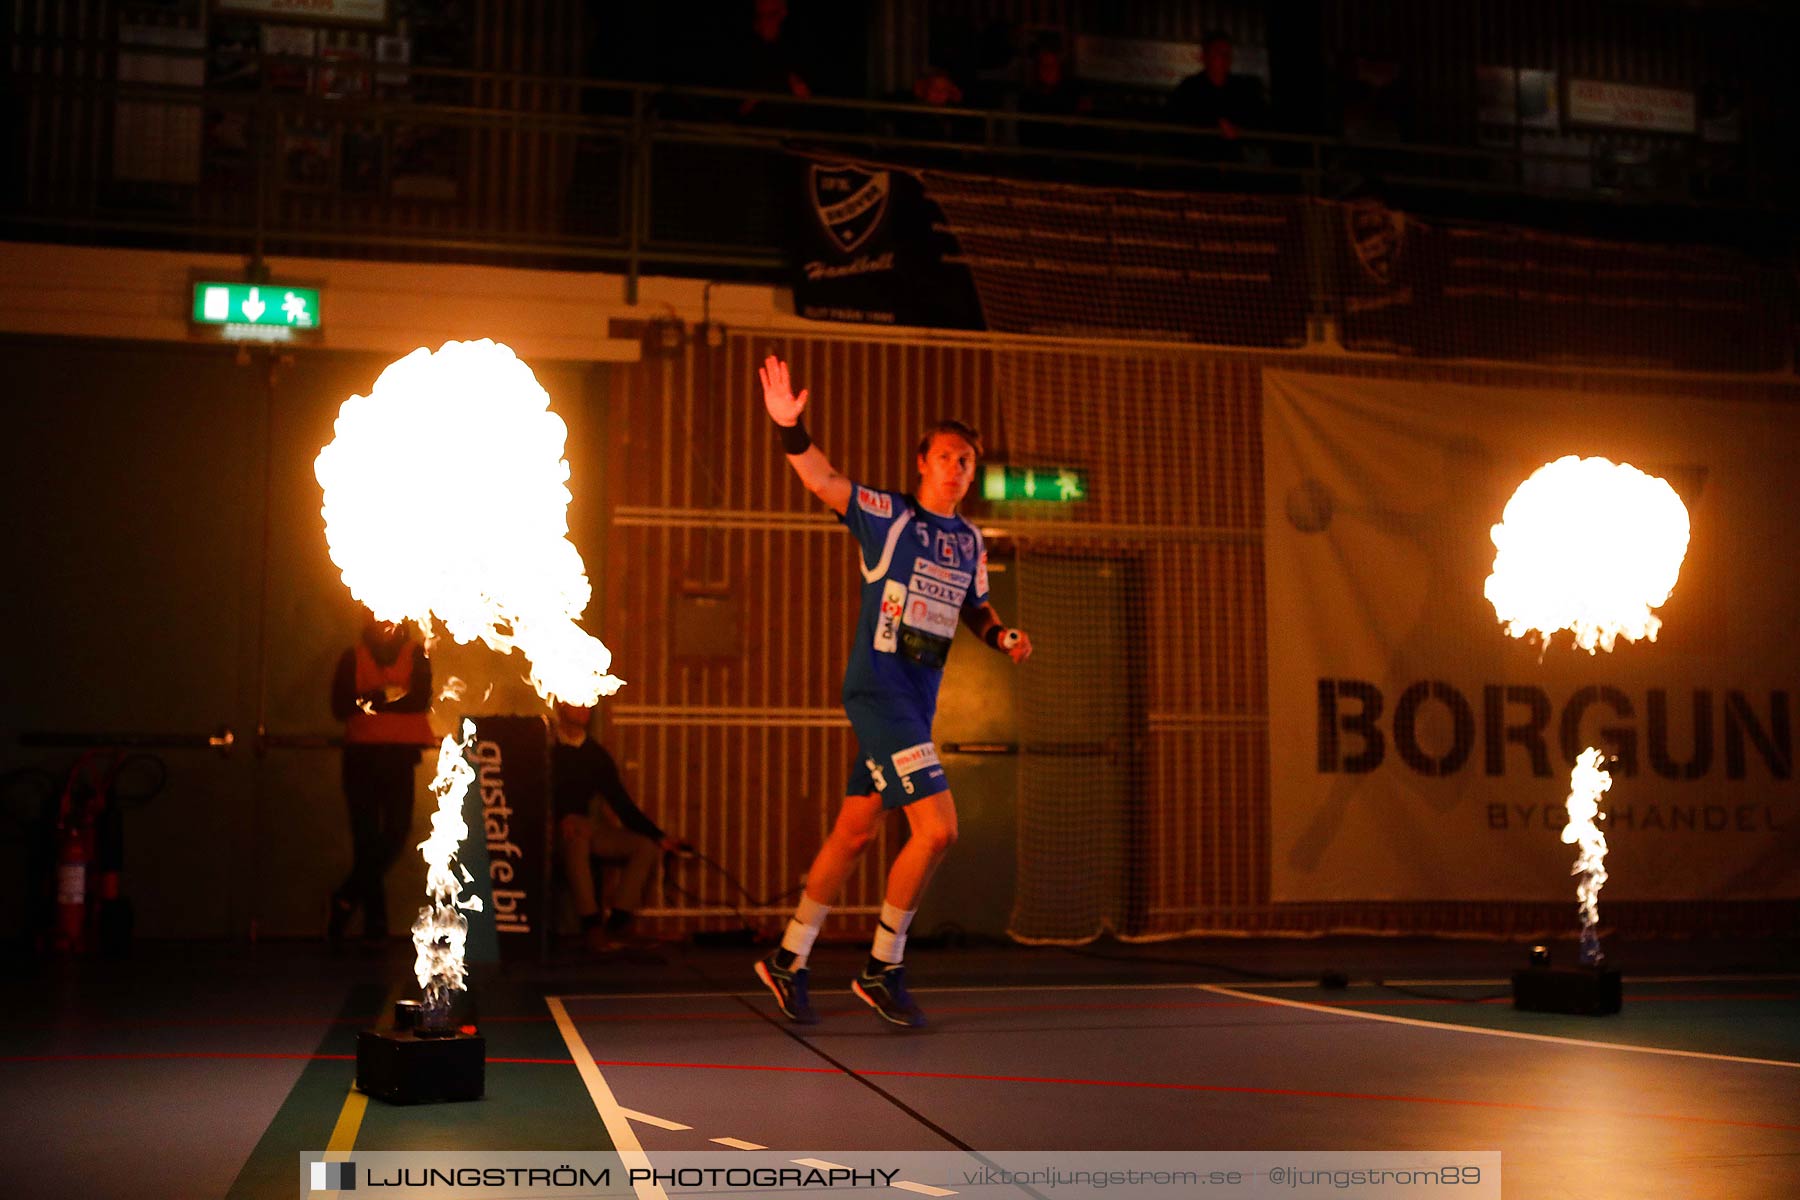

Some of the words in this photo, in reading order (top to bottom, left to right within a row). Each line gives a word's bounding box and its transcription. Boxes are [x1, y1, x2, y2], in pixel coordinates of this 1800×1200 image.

[915, 521, 930, 548] 5
[1317, 678, 1791, 781] BORGUN
[1487, 803, 1787, 833] BYGHANDEL
